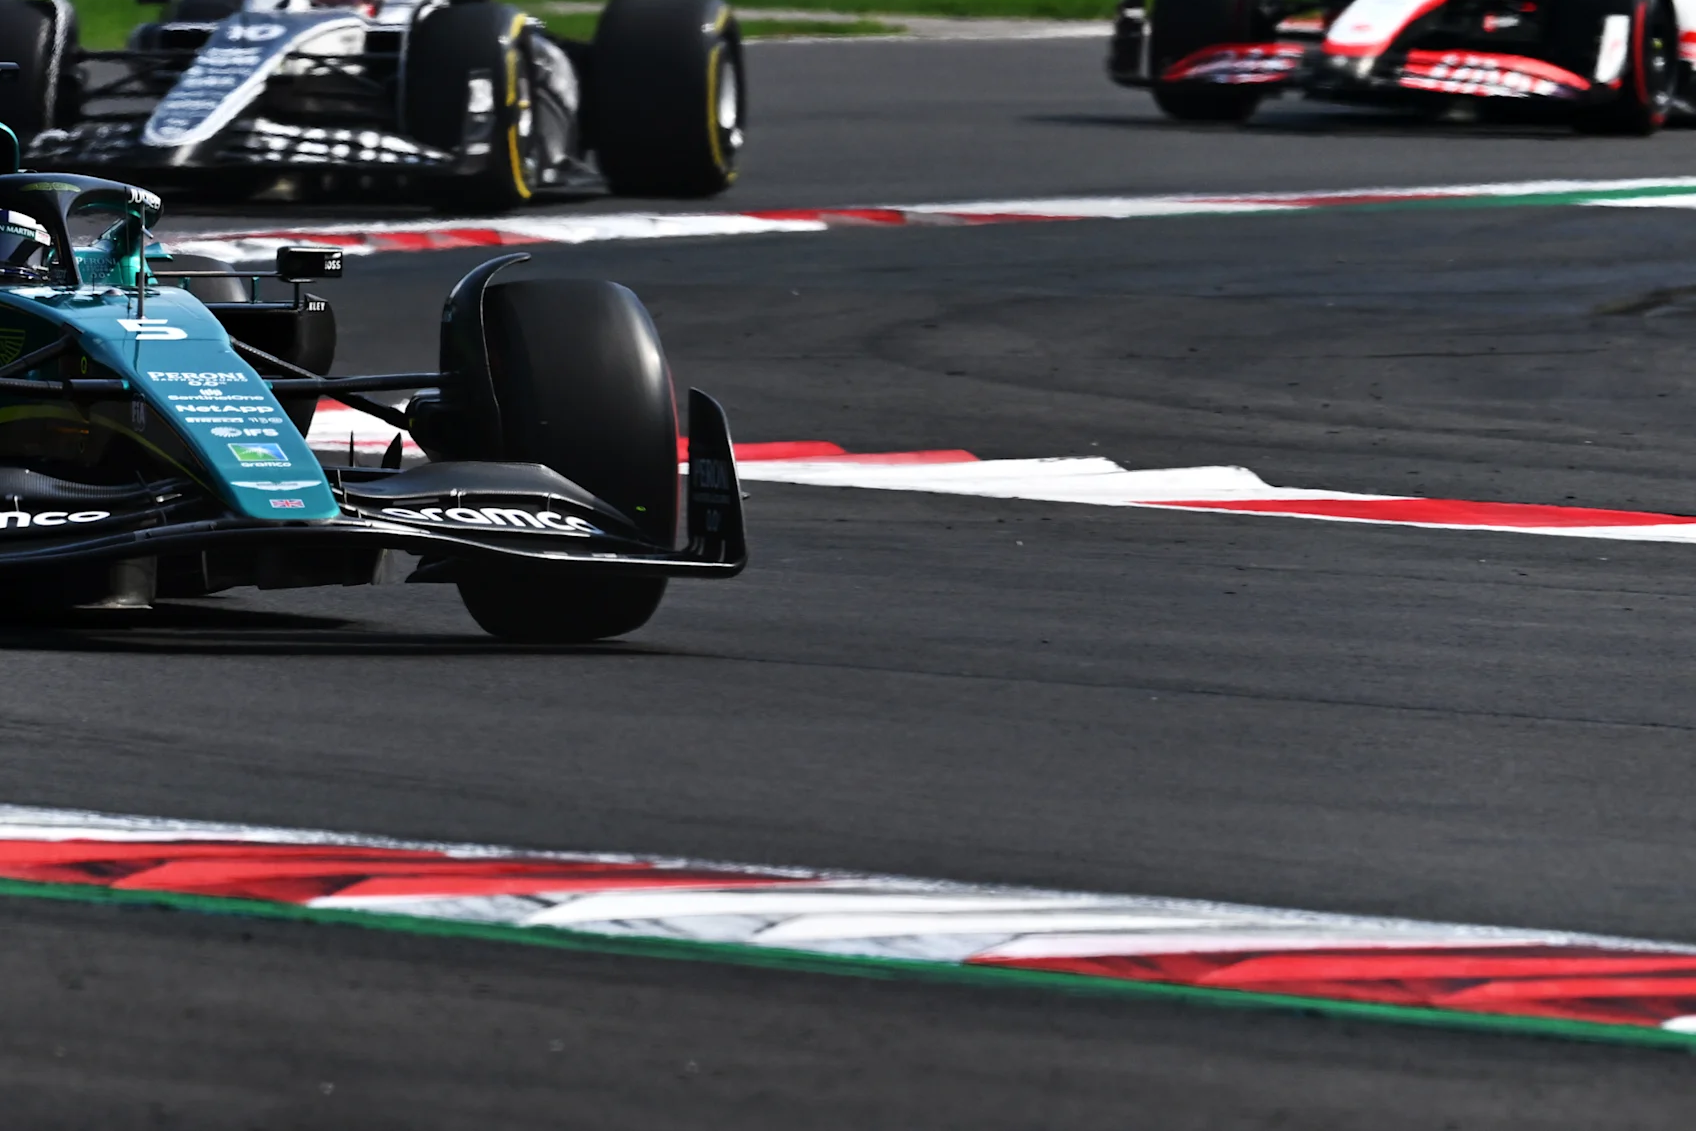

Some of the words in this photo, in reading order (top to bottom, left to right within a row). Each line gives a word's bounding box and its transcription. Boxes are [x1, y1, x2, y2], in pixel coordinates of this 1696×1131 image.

[6, 225, 36, 238] MARTIN
[117, 318, 188, 340] 5
[146, 371, 246, 379] PERONI
[175, 404, 275, 414] NetApp
[243, 428, 280, 437] IFS
